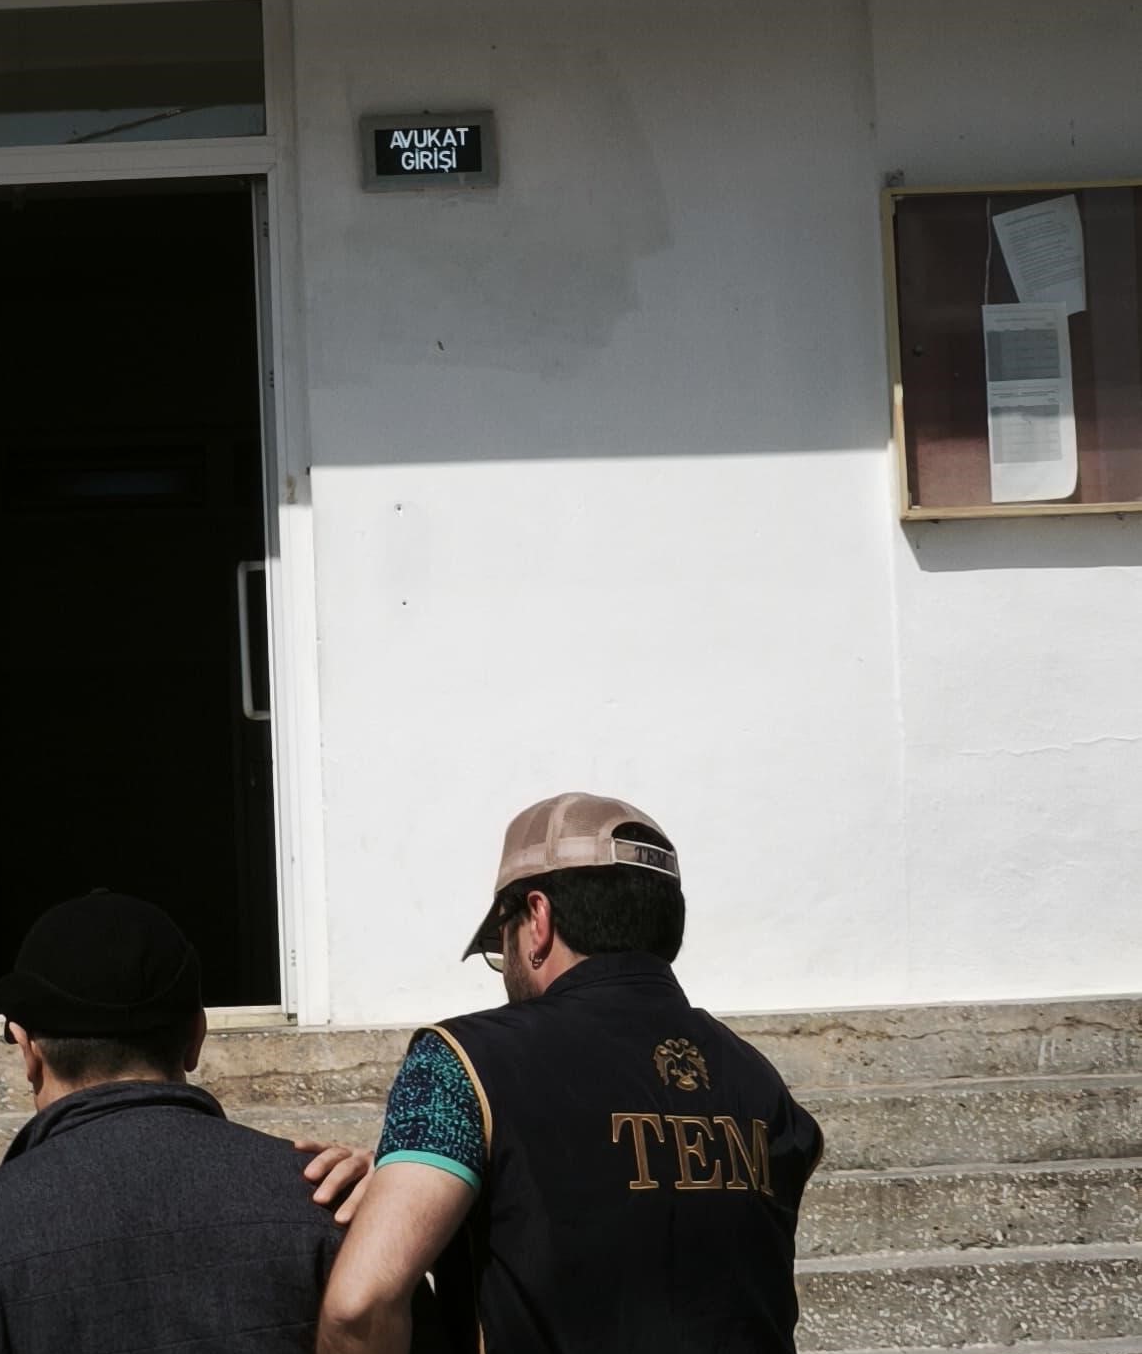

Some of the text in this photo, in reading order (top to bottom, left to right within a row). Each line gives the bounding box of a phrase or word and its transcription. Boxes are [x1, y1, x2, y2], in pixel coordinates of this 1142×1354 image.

[389, 127, 469, 150] AVUKAT
[401, 147, 458, 173] GİRİŞİ
[610, 1111, 775, 1196] TEM
